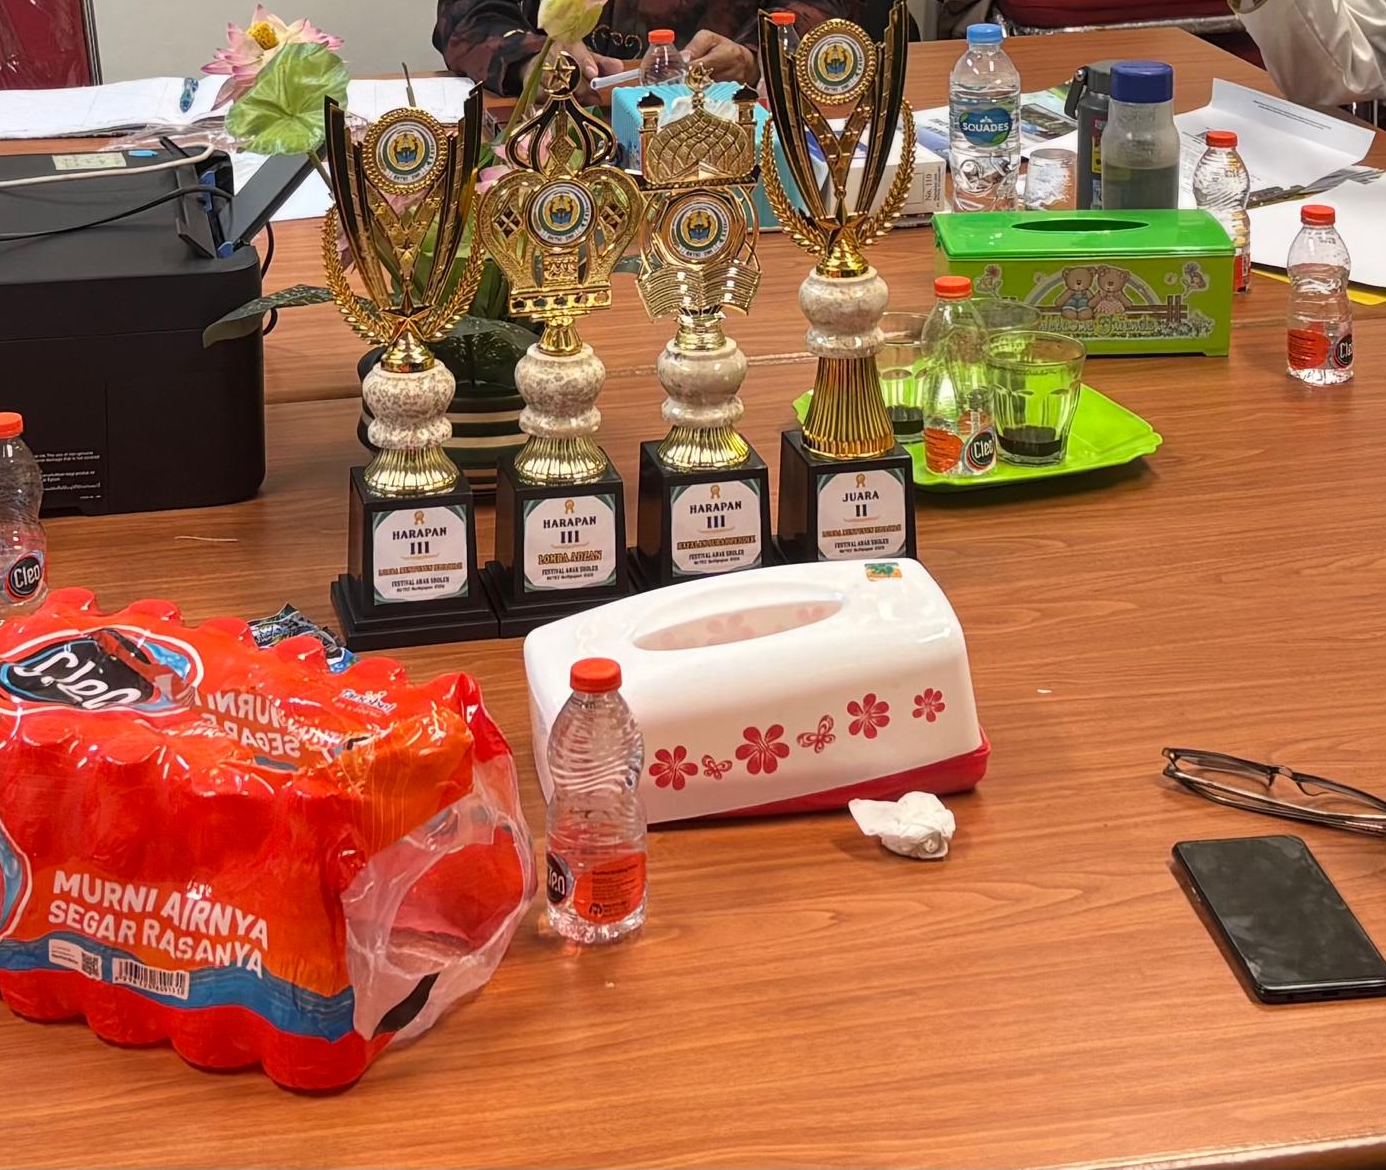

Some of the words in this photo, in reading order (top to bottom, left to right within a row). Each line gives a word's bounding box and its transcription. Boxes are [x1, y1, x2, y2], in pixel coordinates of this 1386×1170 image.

[963, 122, 1009, 133] SQUADES
[843, 491, 879, 502] JUARA
[690, 501, 742, 514] HARAPAN
[856, 504, 867, 517] II
[544, 516, 596, 528] HARAPAN
[707, 515, 725, 528] III
[393, 527, 447, 540] HARAPAN
[561, 531, 579, 543] III
[411, 541, 429, 554] III
[13, 563, 41, 589] Cleo
[53, 870, 158, 913] MURNI
[160, 891, 268, 950] AIRNYA
[48, 899, 137, 945] SEGAR
[142, 918, 263, 979] RASANYA
